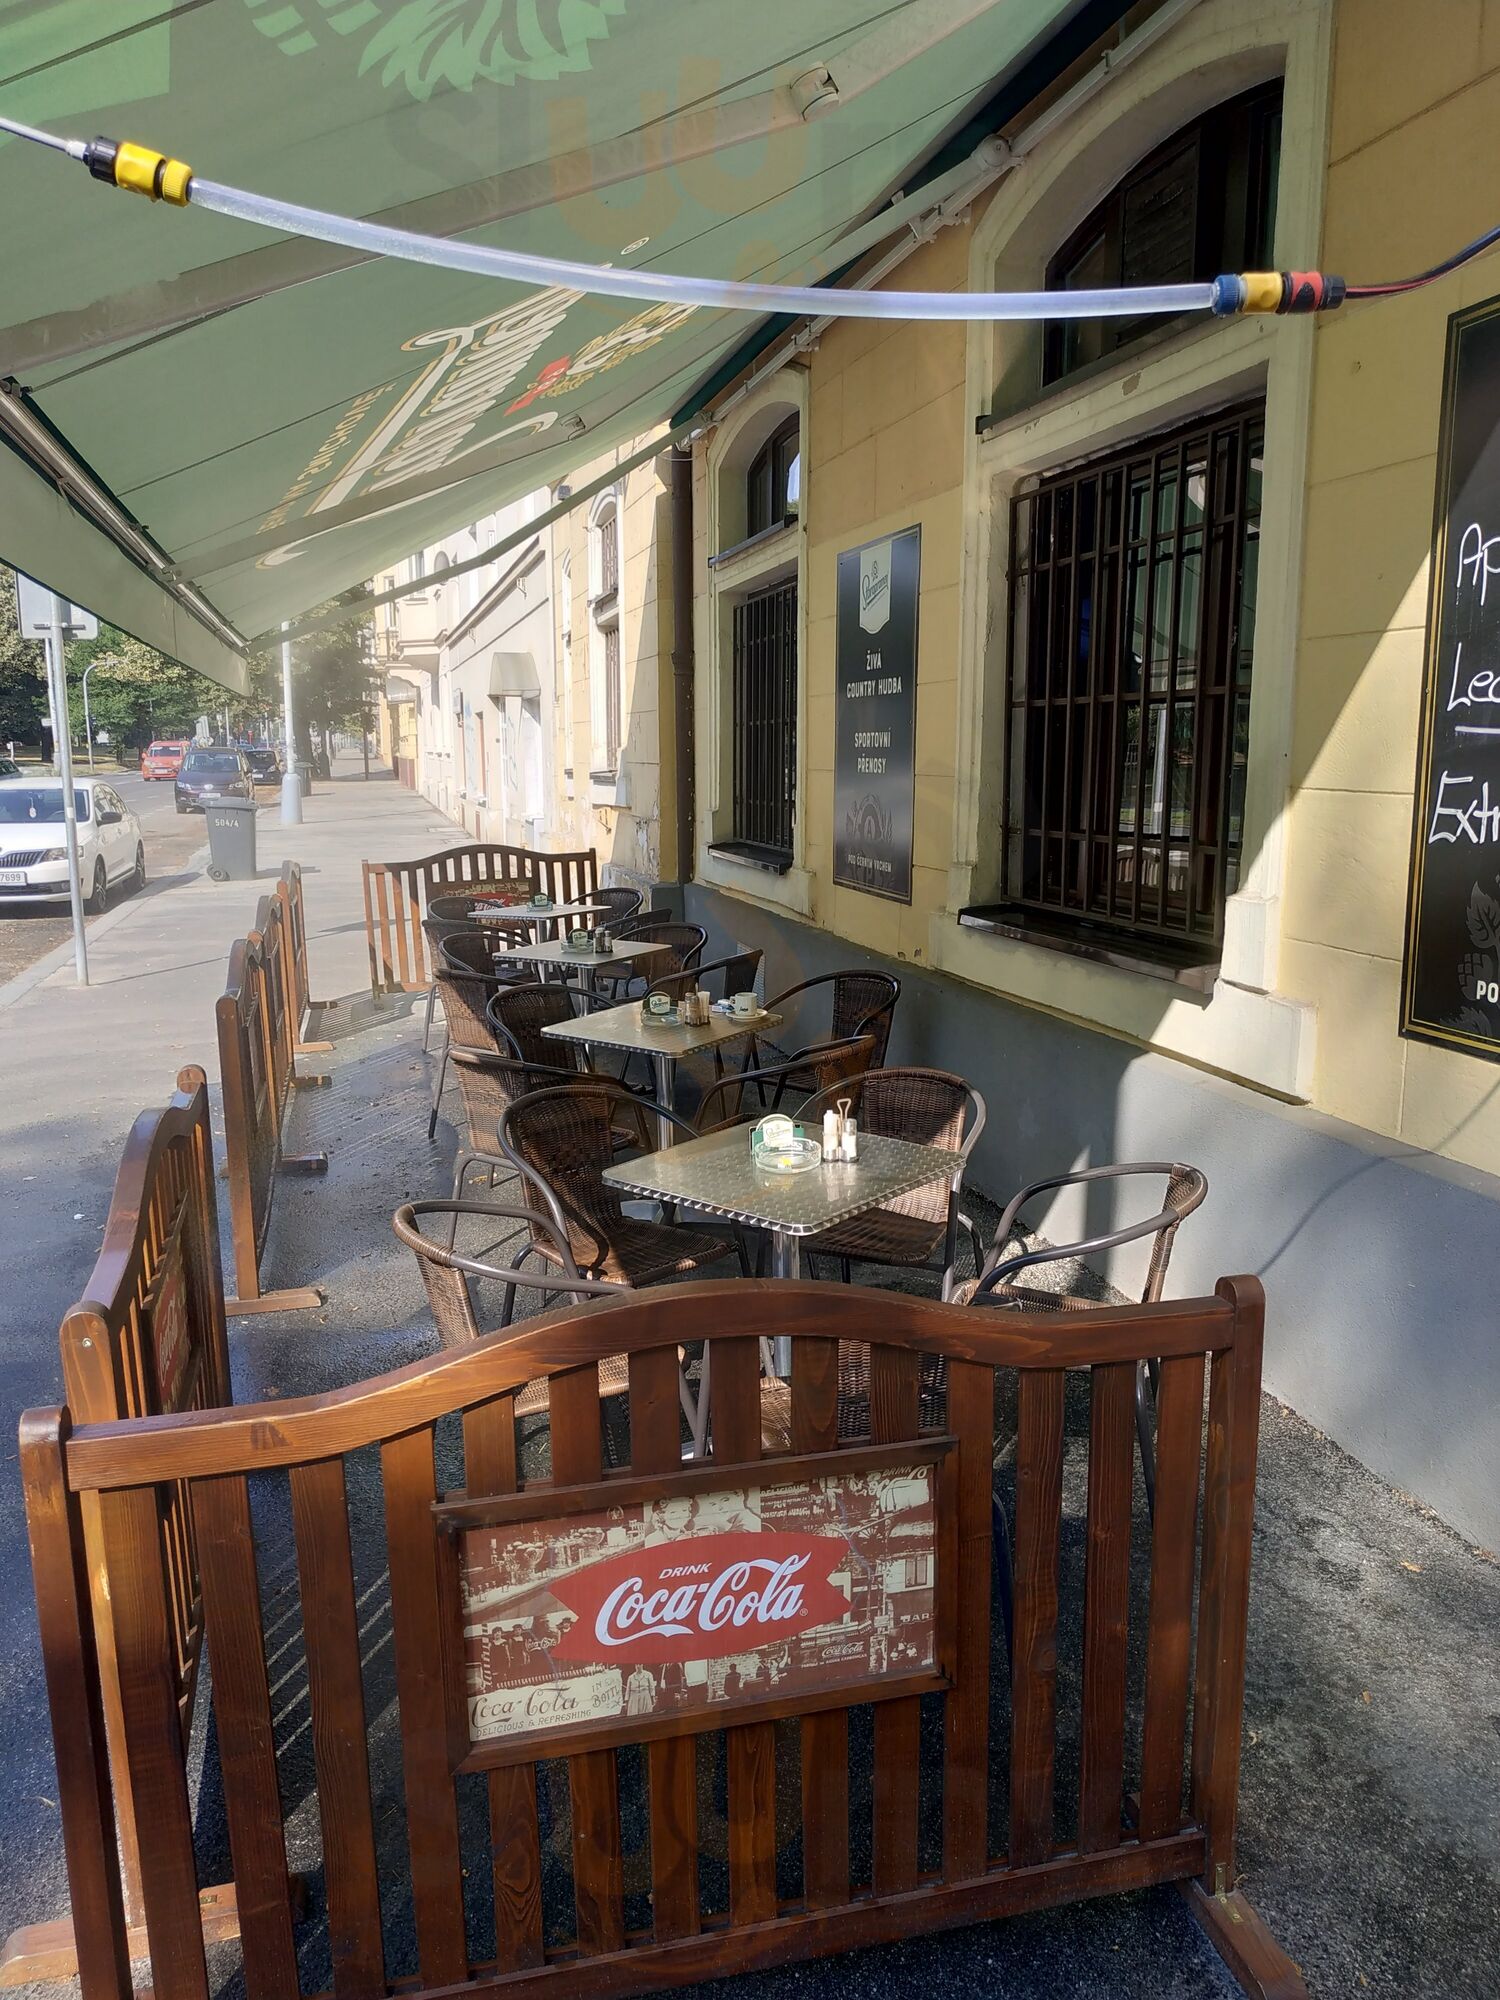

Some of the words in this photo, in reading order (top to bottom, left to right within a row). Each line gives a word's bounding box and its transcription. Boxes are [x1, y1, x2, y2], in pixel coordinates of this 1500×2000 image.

[866, 648, 882, 671] ŽIVÁ
[846, 680, 877, 699] COUNTRY
[877, 677, 903, 696] HUDBA
[854, 727, 892, 748] SPORTOVNÍ
[857, 753, 888, 774] PŘENOSY
[214, 818, 240, 828] 504/4
[658, 1562, 713, 1580] DRINK
[594, 1551, 812, 1647] Coca-Cola
[471, 1686, 580, 1729] Coca-Cola
[476, 1720, 525, 1739] DELICIOUS
[538, 1708, 593, 1726] REFRESHING
